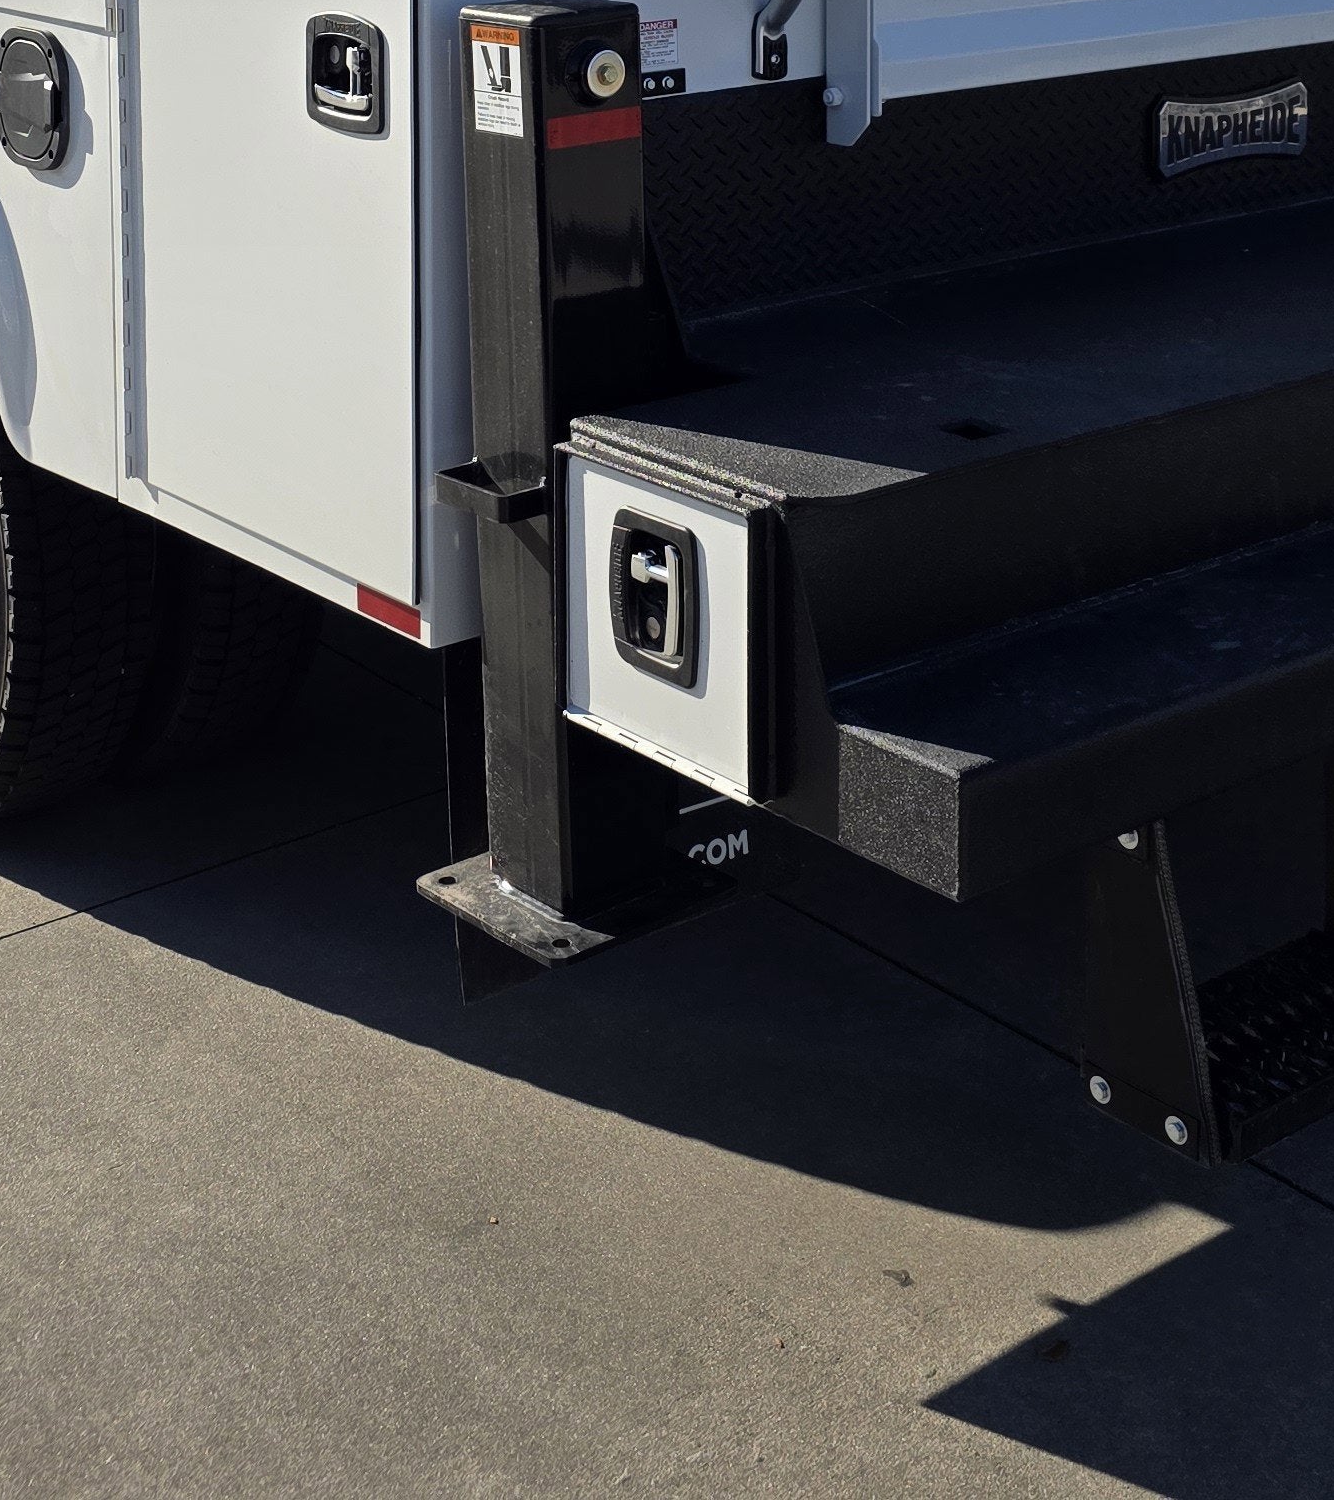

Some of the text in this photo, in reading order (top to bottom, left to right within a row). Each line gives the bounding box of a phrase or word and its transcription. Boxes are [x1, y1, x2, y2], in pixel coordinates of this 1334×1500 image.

[640, 20, 674, 32] DANGER
[482, 29, 515, 42] WARNING
[1167, 94, 1302, 168] KNAPHEIDE
